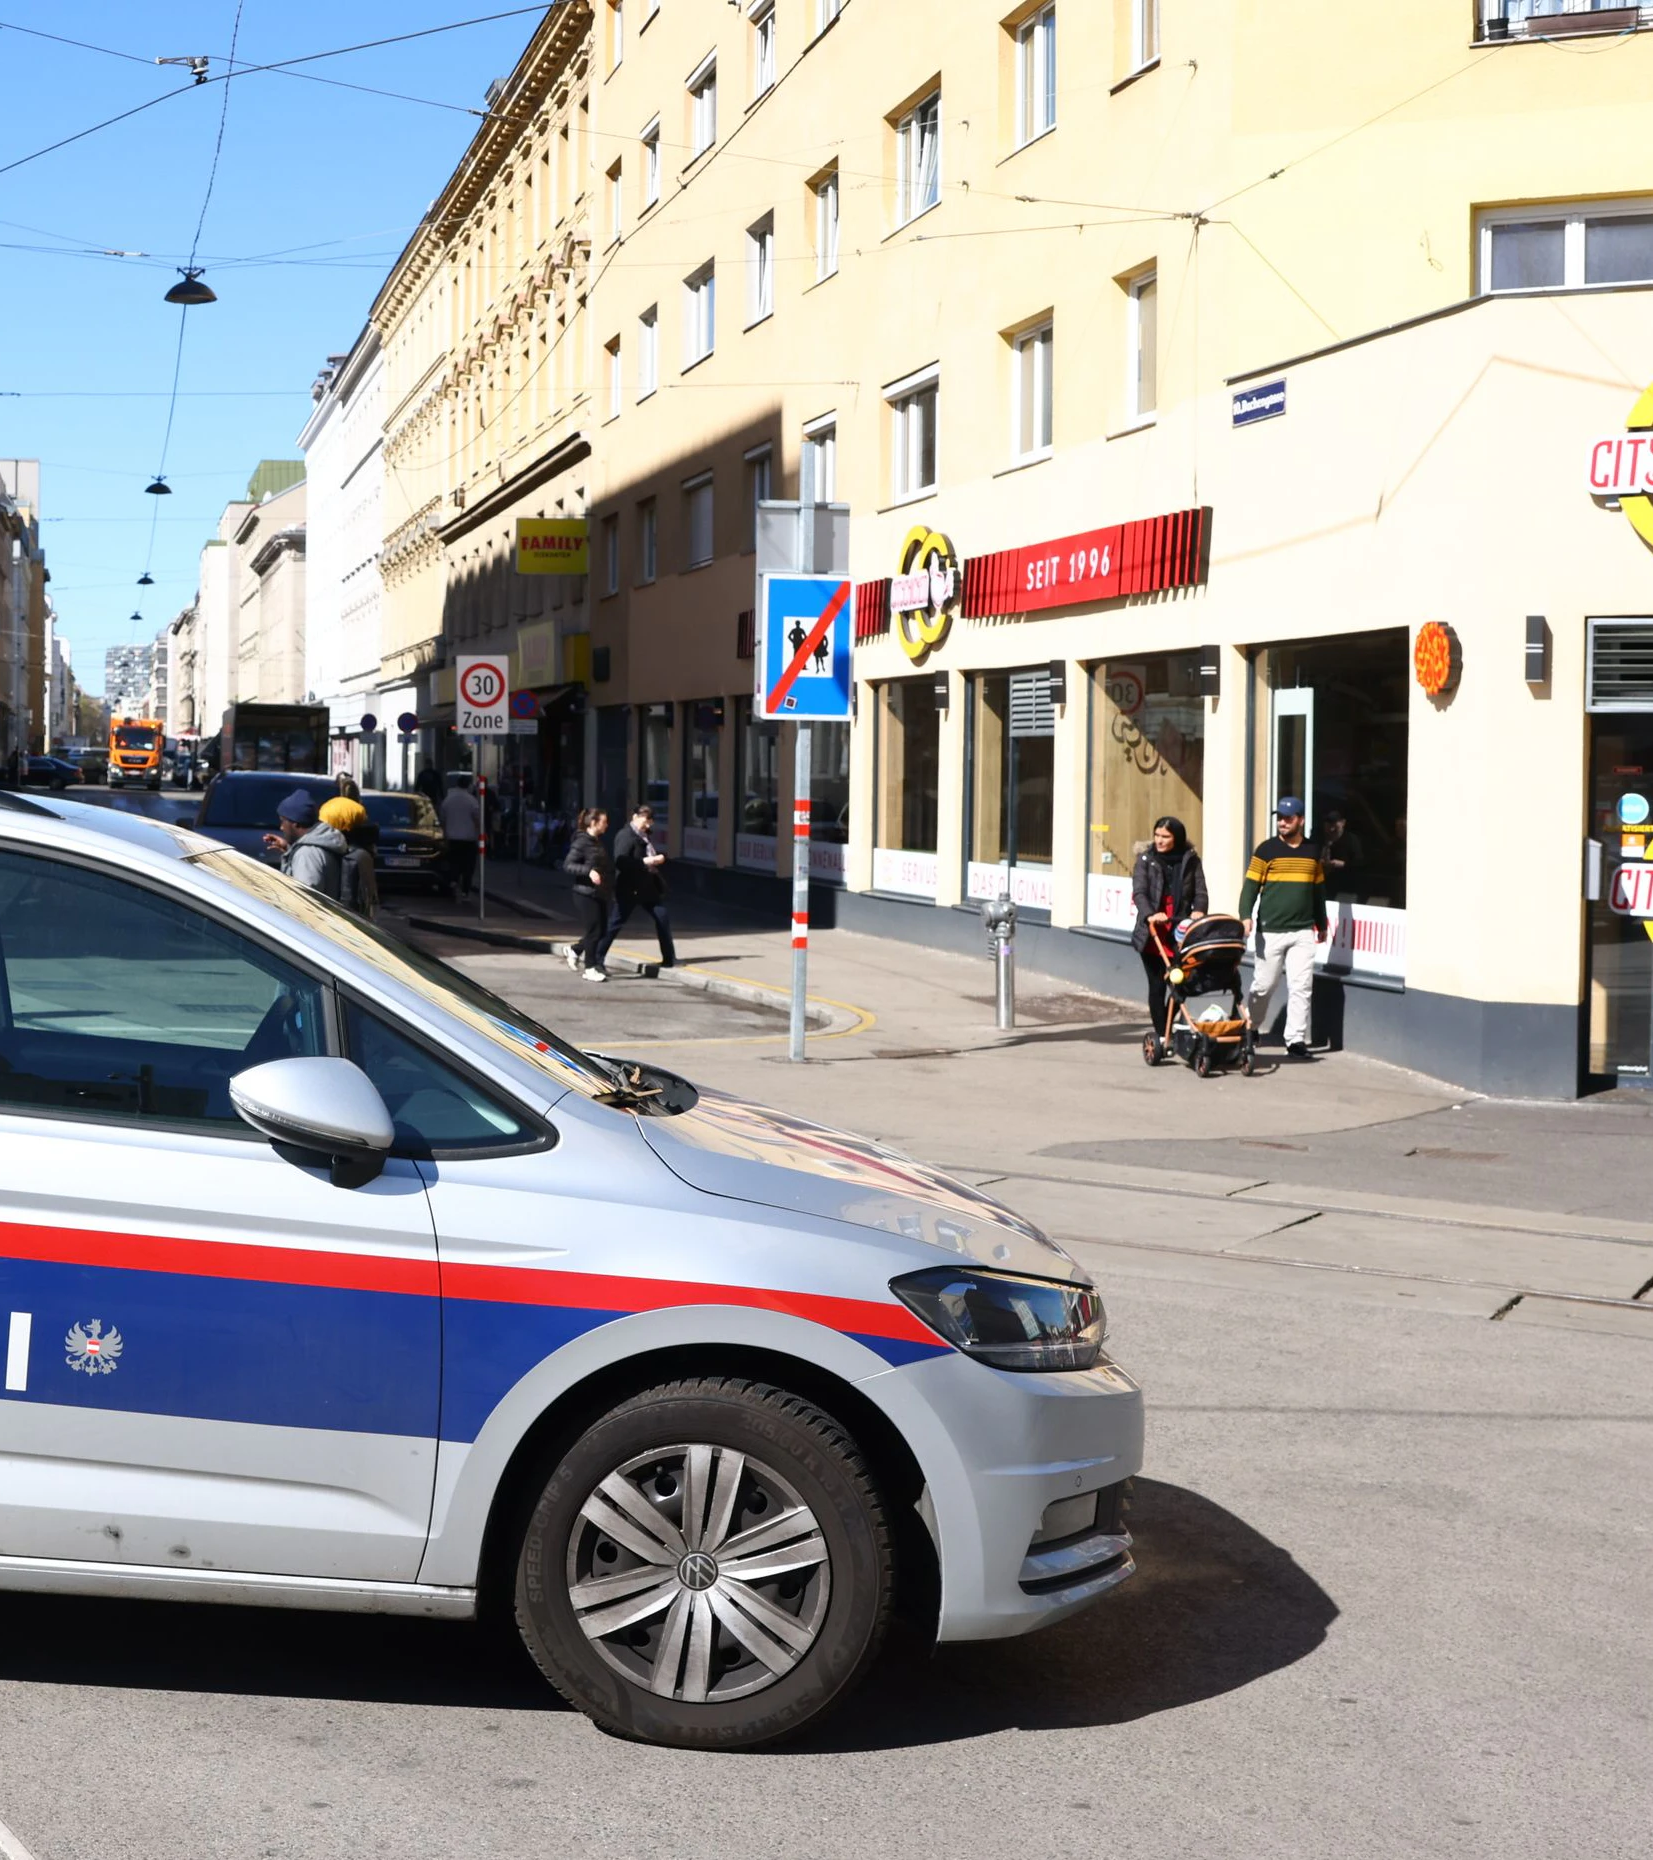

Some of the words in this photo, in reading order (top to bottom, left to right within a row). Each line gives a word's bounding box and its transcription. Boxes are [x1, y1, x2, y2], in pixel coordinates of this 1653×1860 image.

[521, 536, 584, 551] FAMILY
[1026, 555, 1060, 591] SEIT
[1068, 544, 1110, 583] 1996
[472, 675, 494, 696] 30
[462, 711, 503, 729] Zone
[901, 860, 938, 886] SERVUS
[972, 872, 993, 896] DAS
[1099, 888, 1122, 917] IST
